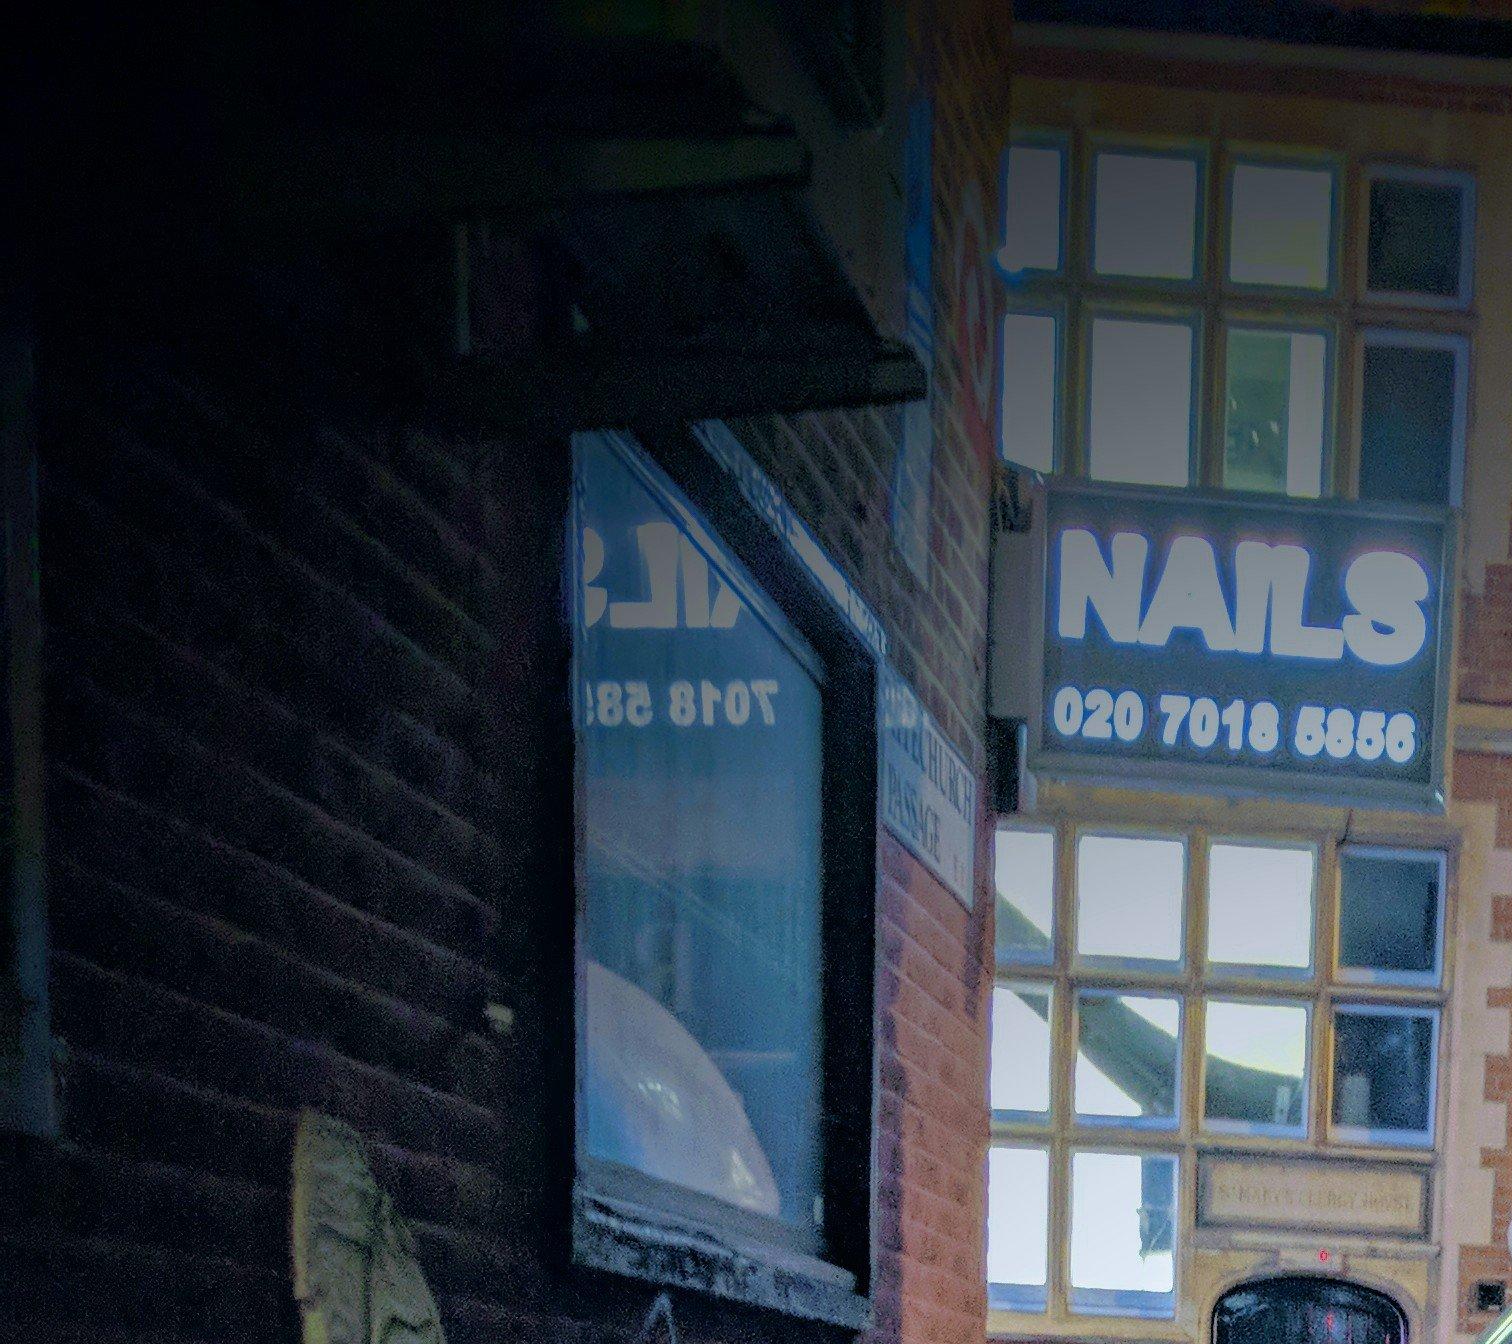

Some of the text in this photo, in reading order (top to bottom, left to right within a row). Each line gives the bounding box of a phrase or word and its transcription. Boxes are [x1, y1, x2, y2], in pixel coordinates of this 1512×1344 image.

[1057, 528, 1430, 667] NAILS
[1053, 686, 1416, 763] 020 7018 5856
